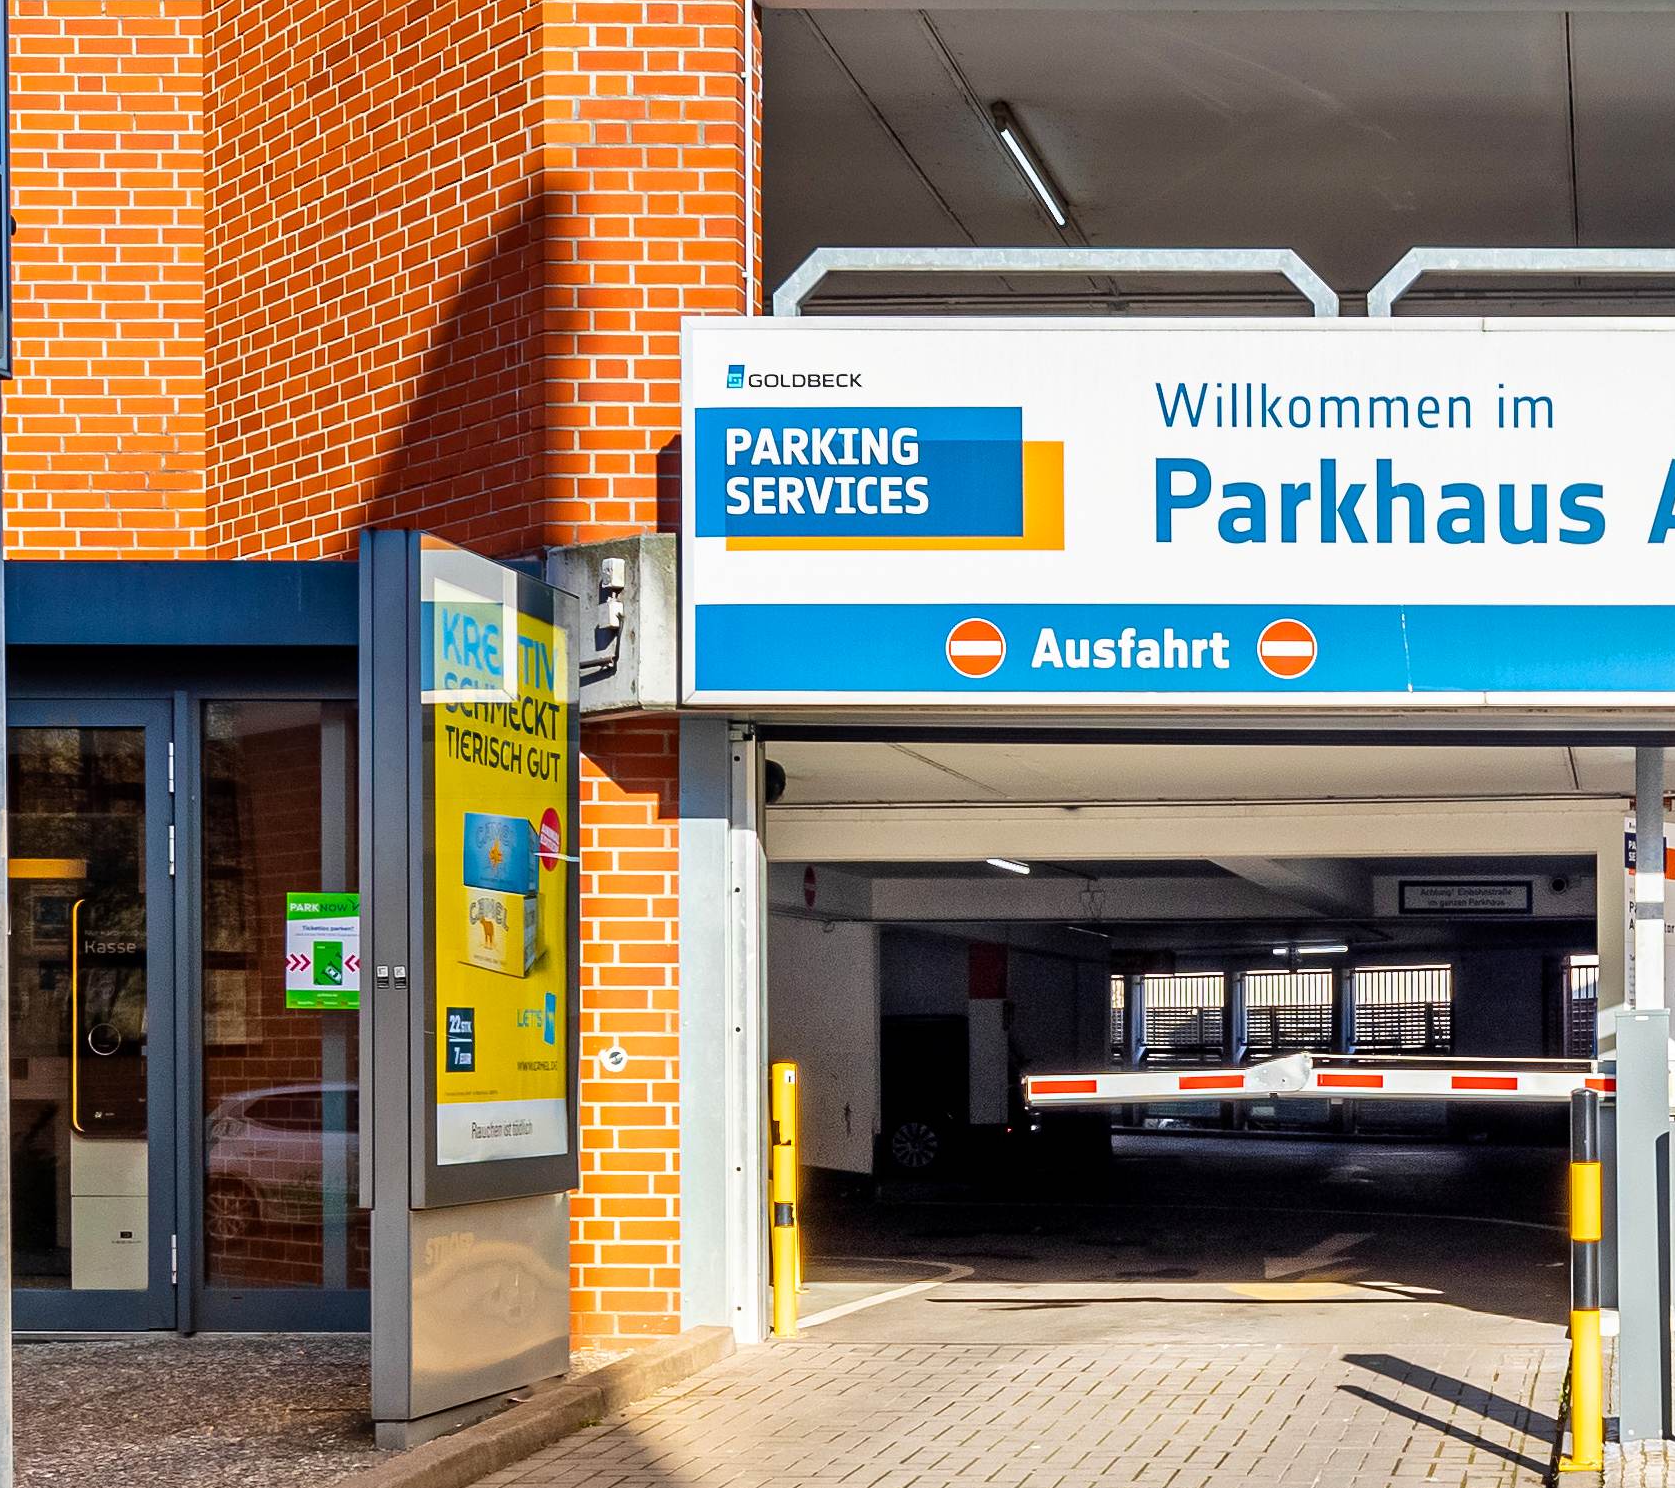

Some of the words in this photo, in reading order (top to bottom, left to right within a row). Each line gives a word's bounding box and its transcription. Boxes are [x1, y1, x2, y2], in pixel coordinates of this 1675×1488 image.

[748, 373, 863, 388] GOLDBECK
[1155, 382, 1472, 428] Willkommen
[1498, 383, 1555, 428] im
[726, 426, 920, 466] PARKING
[726, 475, 930, 515] SERVICES
[1155, 457, 1607, 545] Parkhaus
[441, 607, 557, 692] KRETIV
[1031, 627, 1230, 669] Ausfahrt
[444, 672, 560, 741] SCHMECKT
[445, 725, 522, 774] TIERISCH
[527, 747, 561, 783] GUT
[85, 940, 137, 954] Kasse
[471, 1120, 502, 1140] Rauchen
